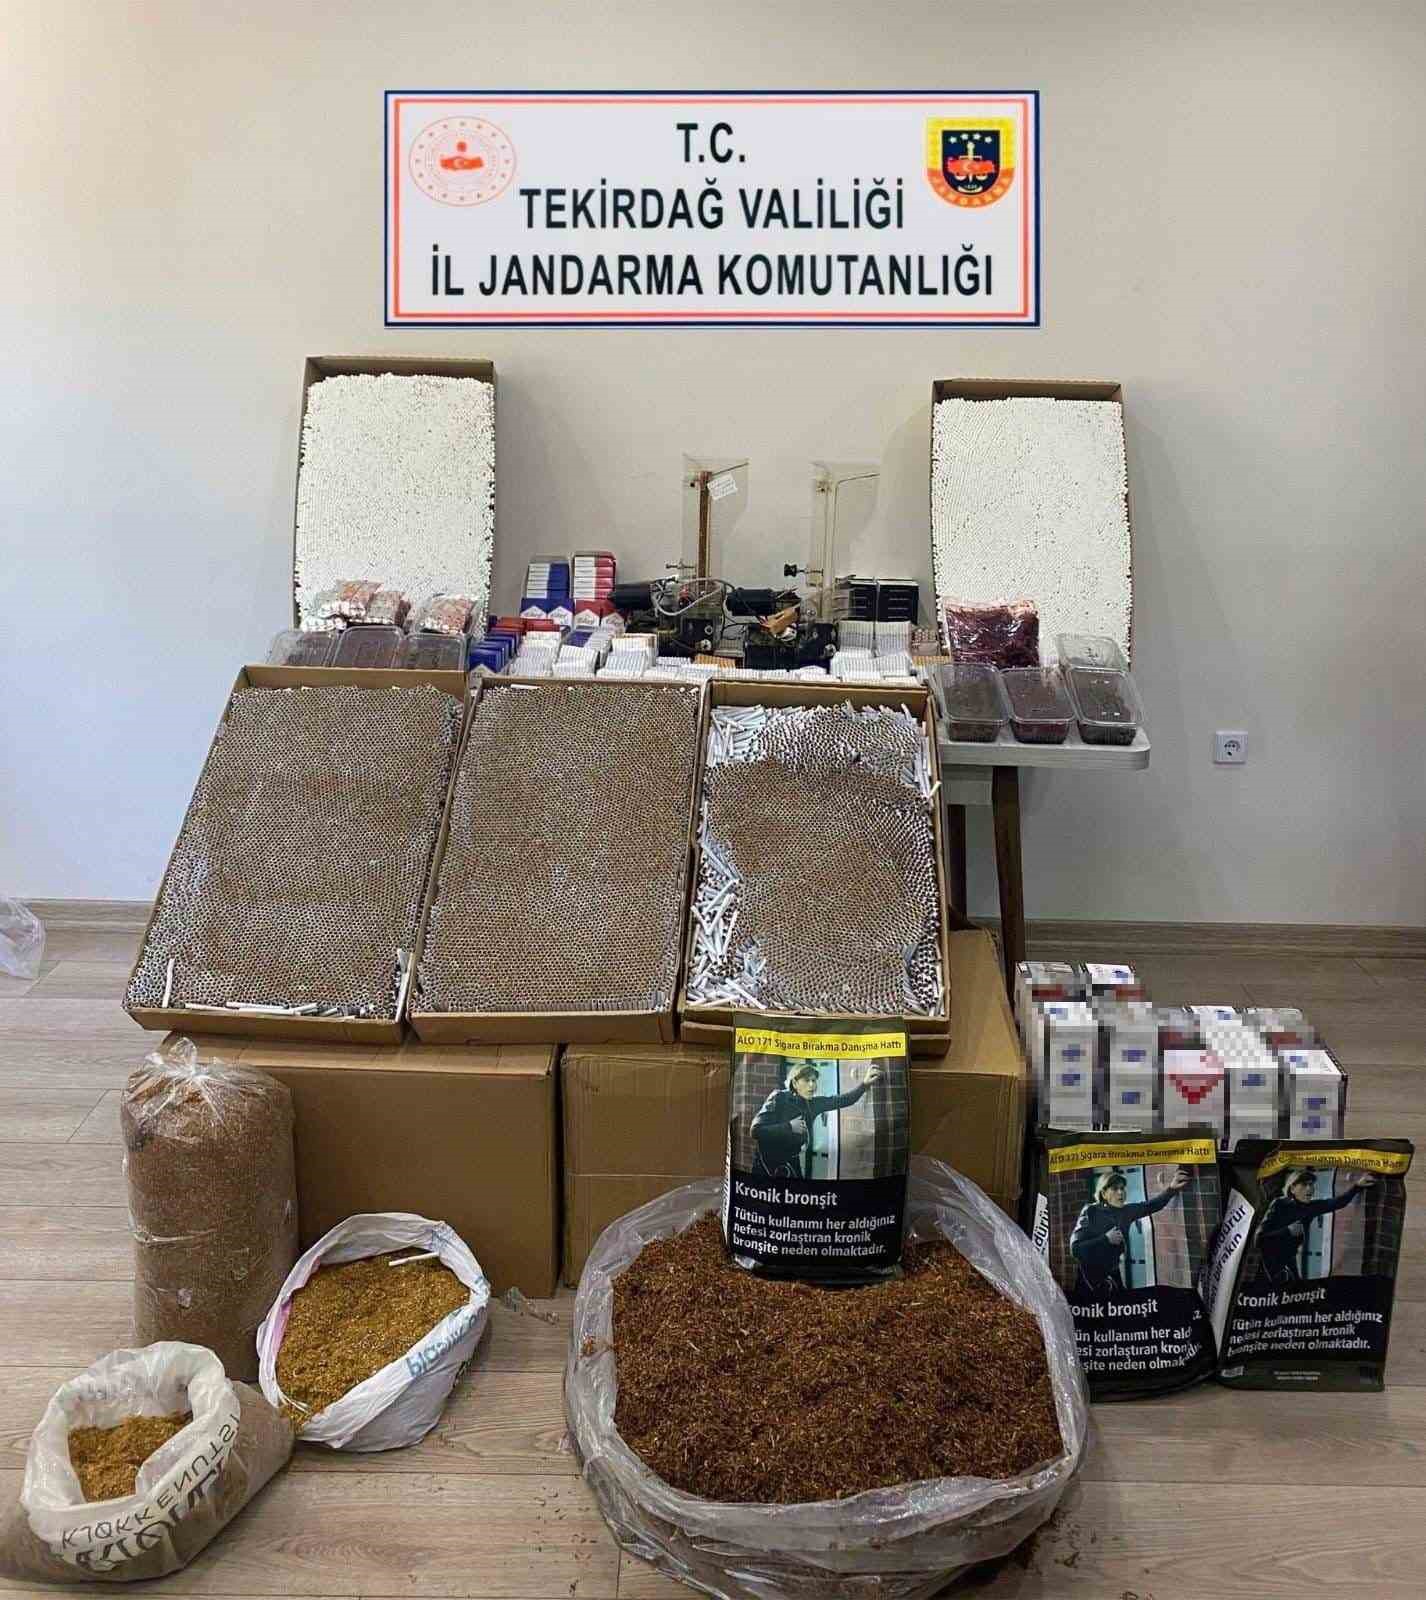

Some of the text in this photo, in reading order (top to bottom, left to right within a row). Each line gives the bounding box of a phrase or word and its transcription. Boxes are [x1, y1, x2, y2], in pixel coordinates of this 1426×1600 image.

[677, 123, 744, 163] T.C.
[520, 178, 902, 229] TEKİRDAĞ VALİLİĞİ
[433, 244, 991, 296] İL JANDARMA KOMUTANLIĞI
[736, 1035, 755, 1045] ALO
[757, 1036, 773, 1046] 171
[774, 1039, 801, 1051] Sigara
[735, 1181, 838, 1209] Kronik bronşit
[734, 1206, 896, 1231] Tütün kullanımı her aldığınız
[734, 1222, 871, 1247] nefesi zorlaştıran kronik
[732, 1234, 887, 1257] bronşite neden olmaktadır.
[1281, 1287, 1327, 1304] bronşit
[1071, 1299, 1158, 1318] onik bronşit
[1314, 1311, 1333, 1324] her
[1335, 1310, 1383, 1325] aldığınız
[1093, 1329, 1148, 1343] kullanımı
[1151, 1326, 1171, 1340] her
[1322, 1323, 1356, 1337] kronik
[1095, 1343, 1158, 1360] zorlaştıran
[1270, 1339, 1305, 1350] neden
[1307, 1336, 1371, 1350] olmaktadır.
[1108, 1359, 1146, 1371] neden
